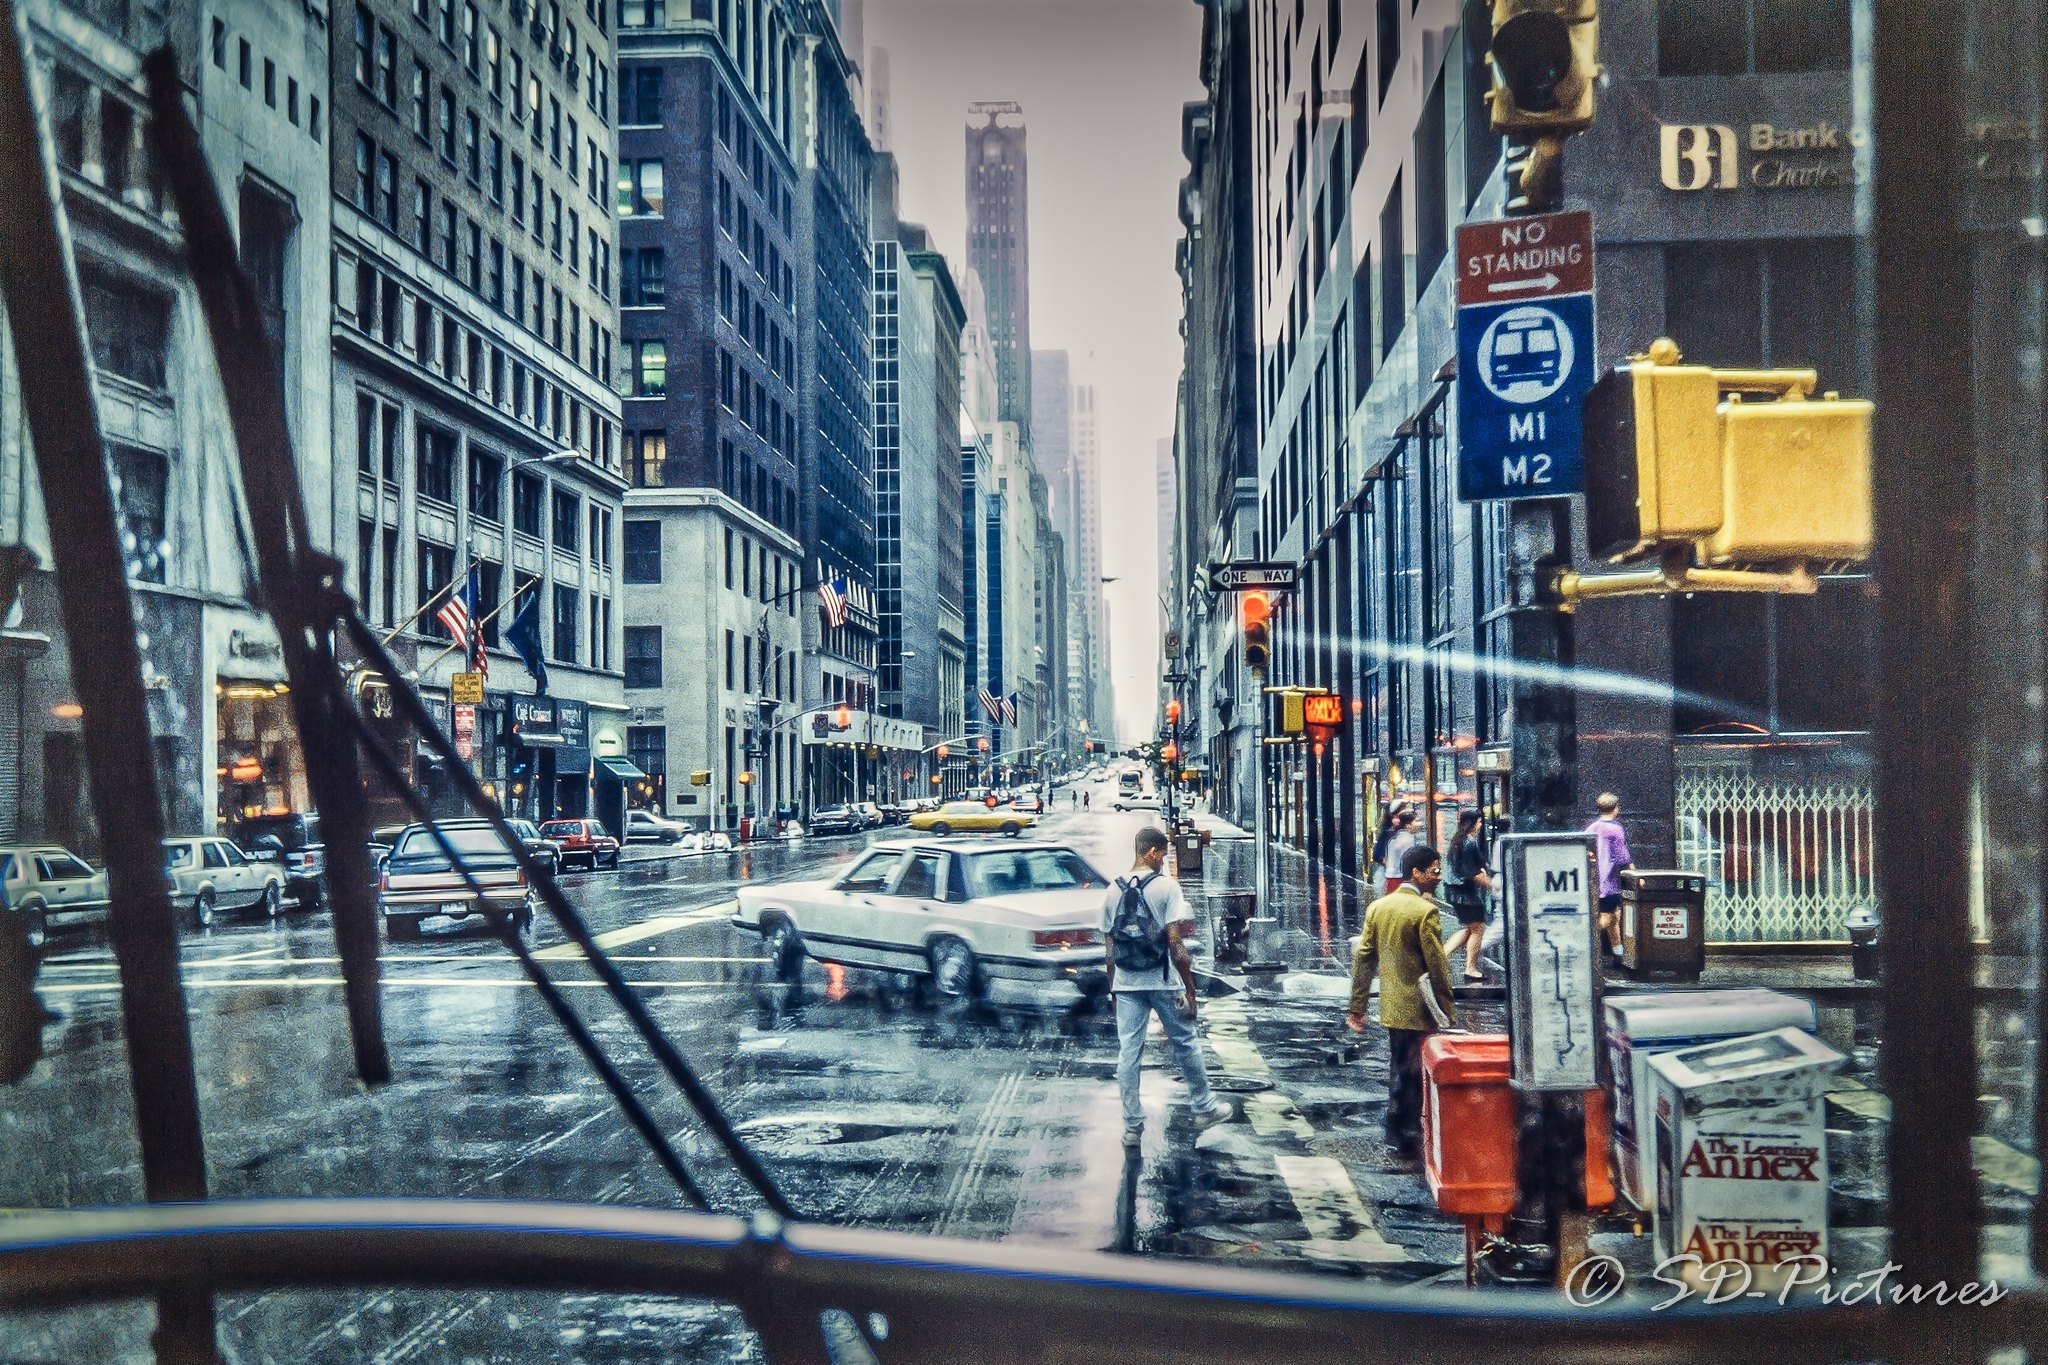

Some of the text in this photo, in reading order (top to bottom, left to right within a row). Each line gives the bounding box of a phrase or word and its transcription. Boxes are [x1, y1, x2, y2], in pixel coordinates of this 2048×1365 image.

[1750, 124, 1838, 150] Bank
[1502, 222, 1546, 247] NO
[1468, 244, 1582, 276] STANDING
[1509, 411, 1546, 442] M1
[1502, 454, 1552, 485] M2
[1222, 569, 1289, 582] ONE WAY
[1545, 868, 1579, 892] M1
[1707, 1138, 1738, 1154] The
[1680, 1139, 1820, 1181] Annex
[1708, 1223, 1740, 1240] The
[1682, 1224, 1822, 1266] Annex
